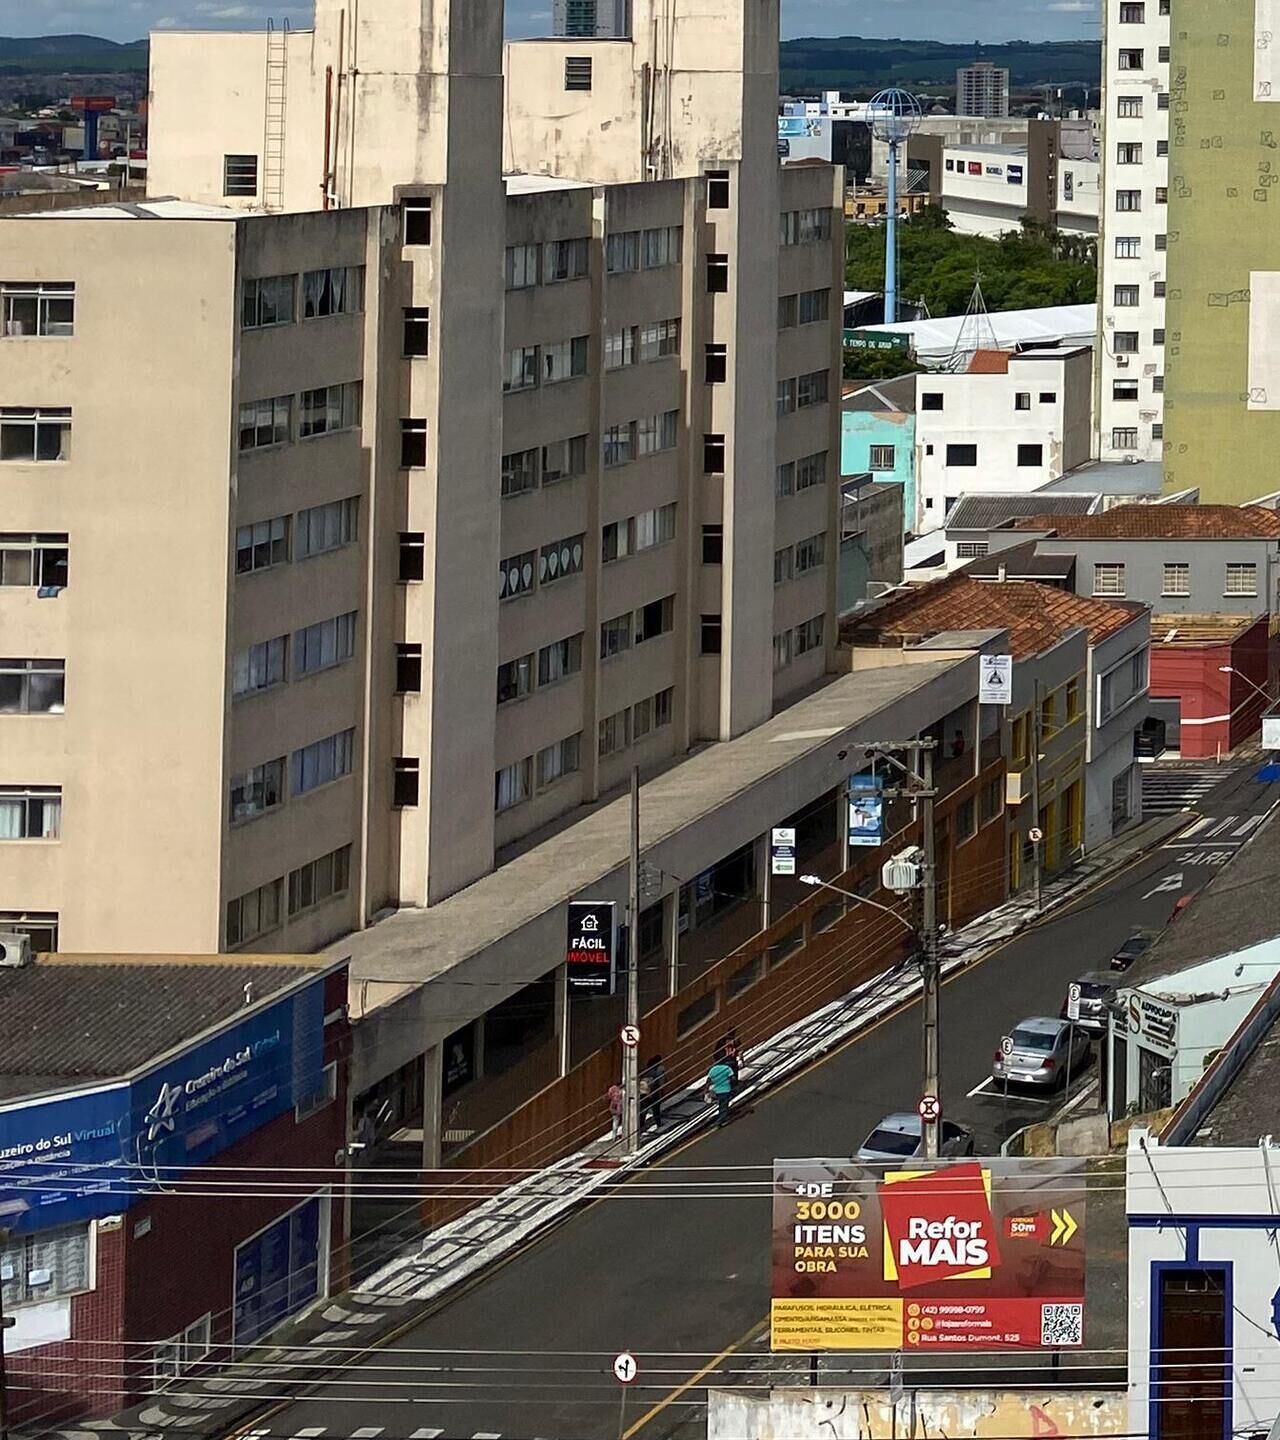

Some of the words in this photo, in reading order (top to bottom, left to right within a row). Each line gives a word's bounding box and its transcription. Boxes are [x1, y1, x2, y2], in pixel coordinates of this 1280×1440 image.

[572, 936, 606, 949] FÁCIL
[568, 950, 609, 963] IMÓVEL
[36, 1138, 51, 1150] do
[53, 1133, 72, 1146] Sul
[74, 1124, 115, 1142] Virtual
[796, 1201, 861, 1220] 3000
[795, 1225, 866, 1244] ITENS
[909, 1216, 982, 1240] Refor
[1011, 1223, 1036, 1233] 50m
[795, 1247, 835, 1258] PARA
[838, 1246, 869, 1258] SUA
[899, 1239, 989, 1266] MAIS
[795, 1261, 837, 1273] OBRA
[921, 1334, 937, 1342] Rua
[939, 1334, 967, 1342] Santos
[1004, 1334, 1020, 1342] 525
